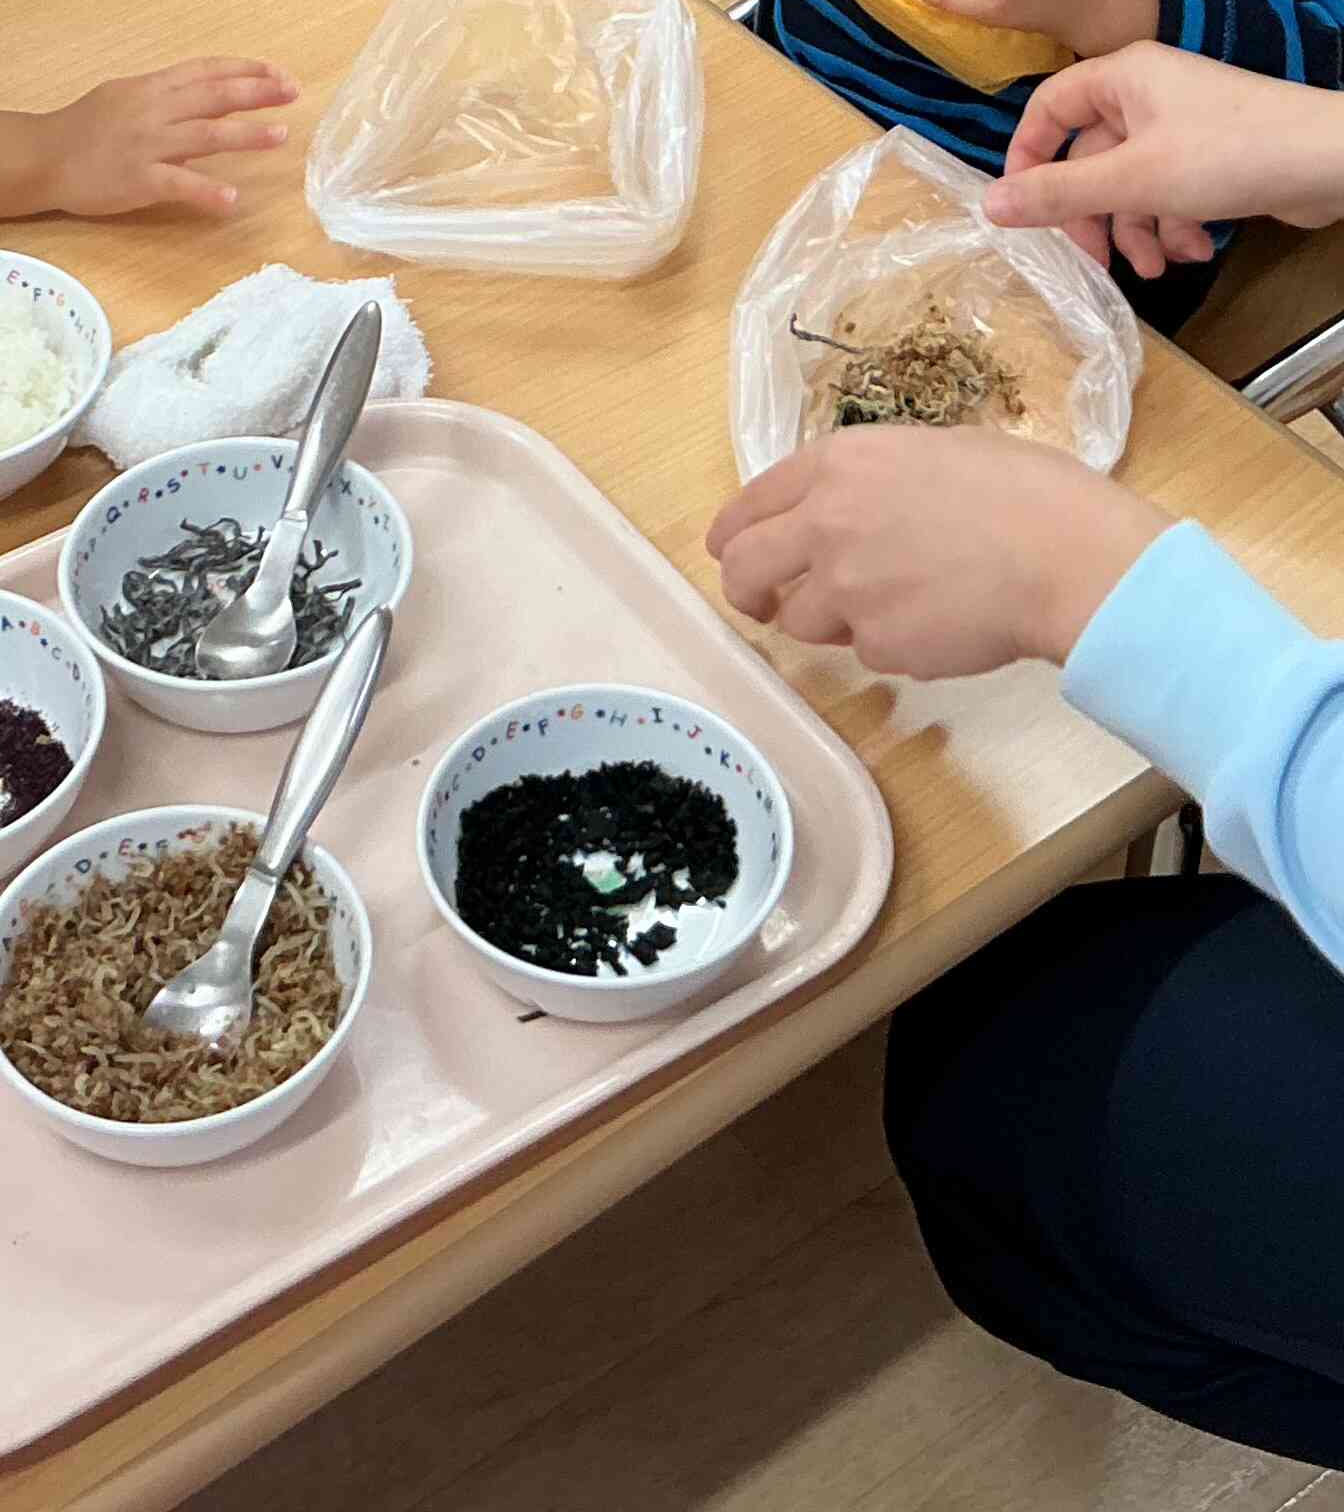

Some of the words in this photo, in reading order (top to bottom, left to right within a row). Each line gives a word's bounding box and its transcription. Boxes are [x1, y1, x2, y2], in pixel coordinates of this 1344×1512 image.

[7, 270, 21, 285] E
[33, 288, 42, 302] F
[106, 506, 122, 524] Q
[137, 487, 150, 503] R
[167, 478, 181, 493] S
[196, 463, 210, 475] T
[233, 466, 248, 480] U
[271, 455, 283, 470] V
[1, 615, 14, 632] A
[51, 647, 62, 660] C
[472, 746, 485, 761] D
[506, 720, 519, 740] E
[571, 703, 584, 719] G
[610, 710, 627, 726] H
[652, 707, 663, 723] I
[687, 725, 703, 739] J
[720, 749, 730, 768] K
[74, 858, 92, 874] D
[118, 838, 134, 856] E
